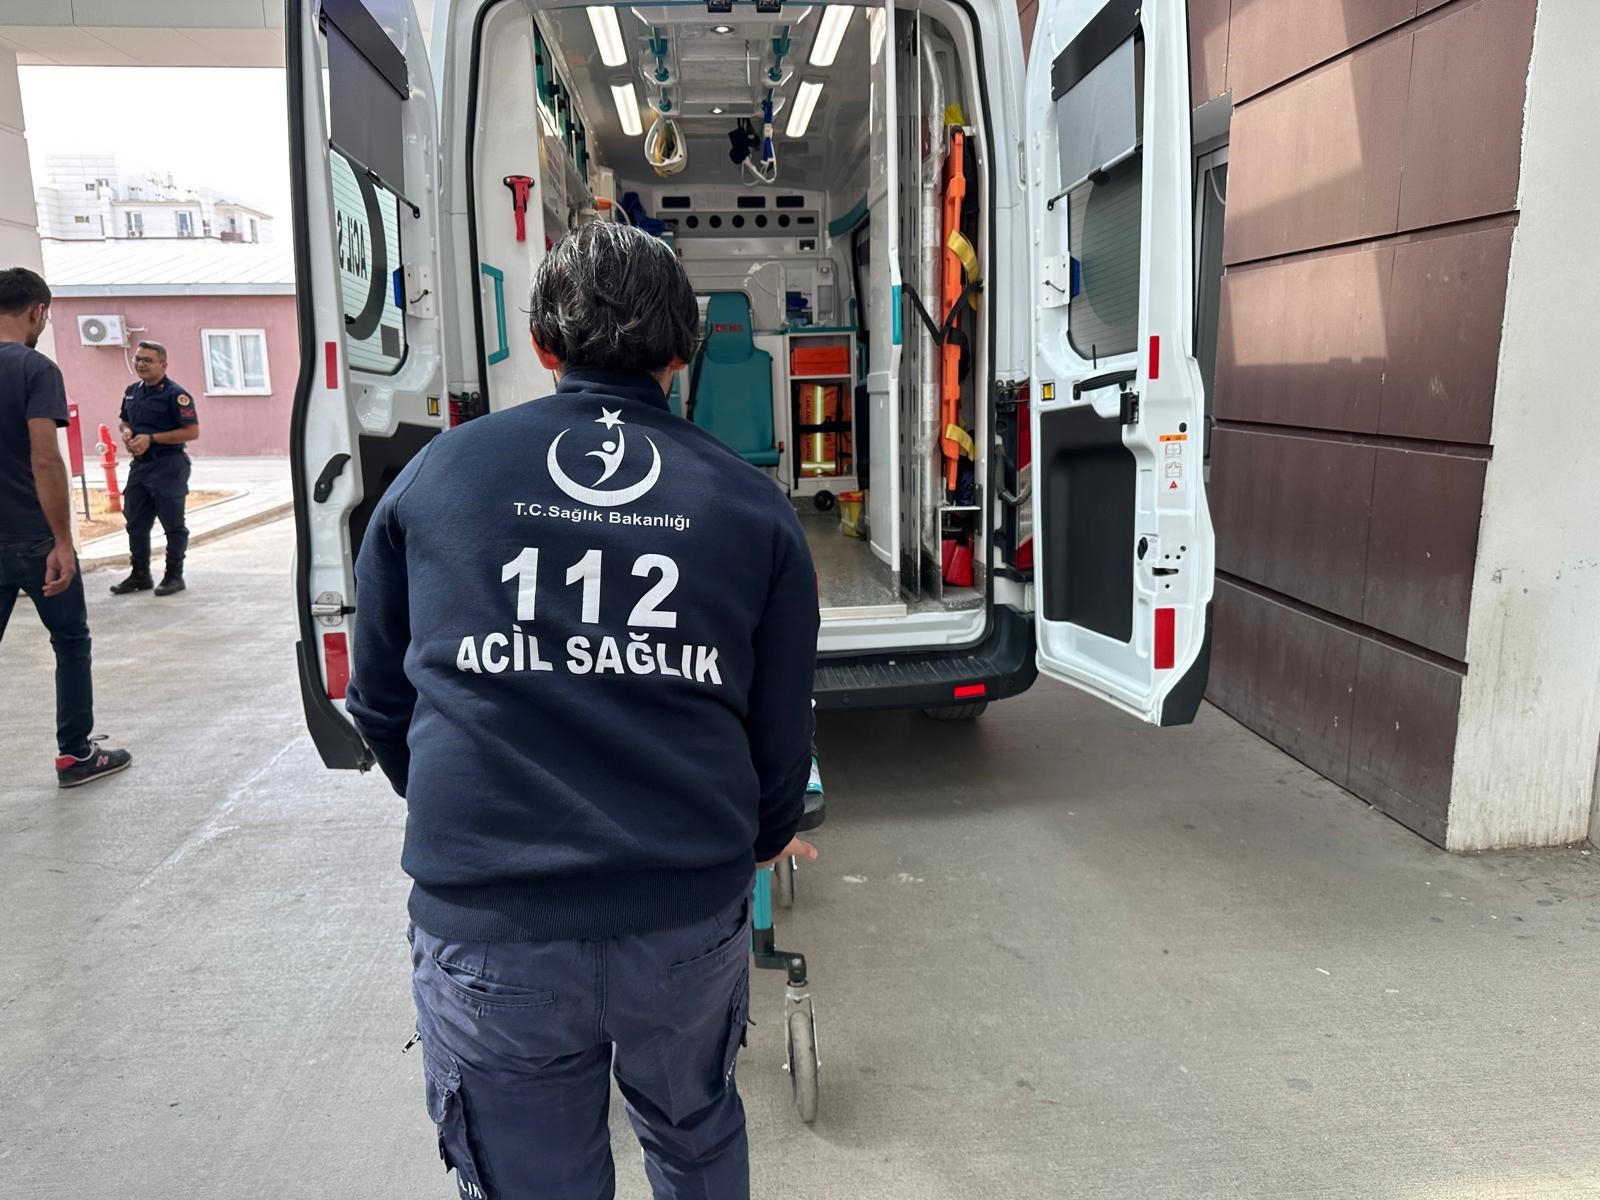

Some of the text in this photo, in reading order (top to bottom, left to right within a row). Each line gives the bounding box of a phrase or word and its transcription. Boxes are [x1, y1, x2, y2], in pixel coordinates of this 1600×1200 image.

[609, 511, 690, 531] Bakanlığı
[501, 547, 680, 629] 112
[456, 624, 723, 685] ACİL SAĞLIK
